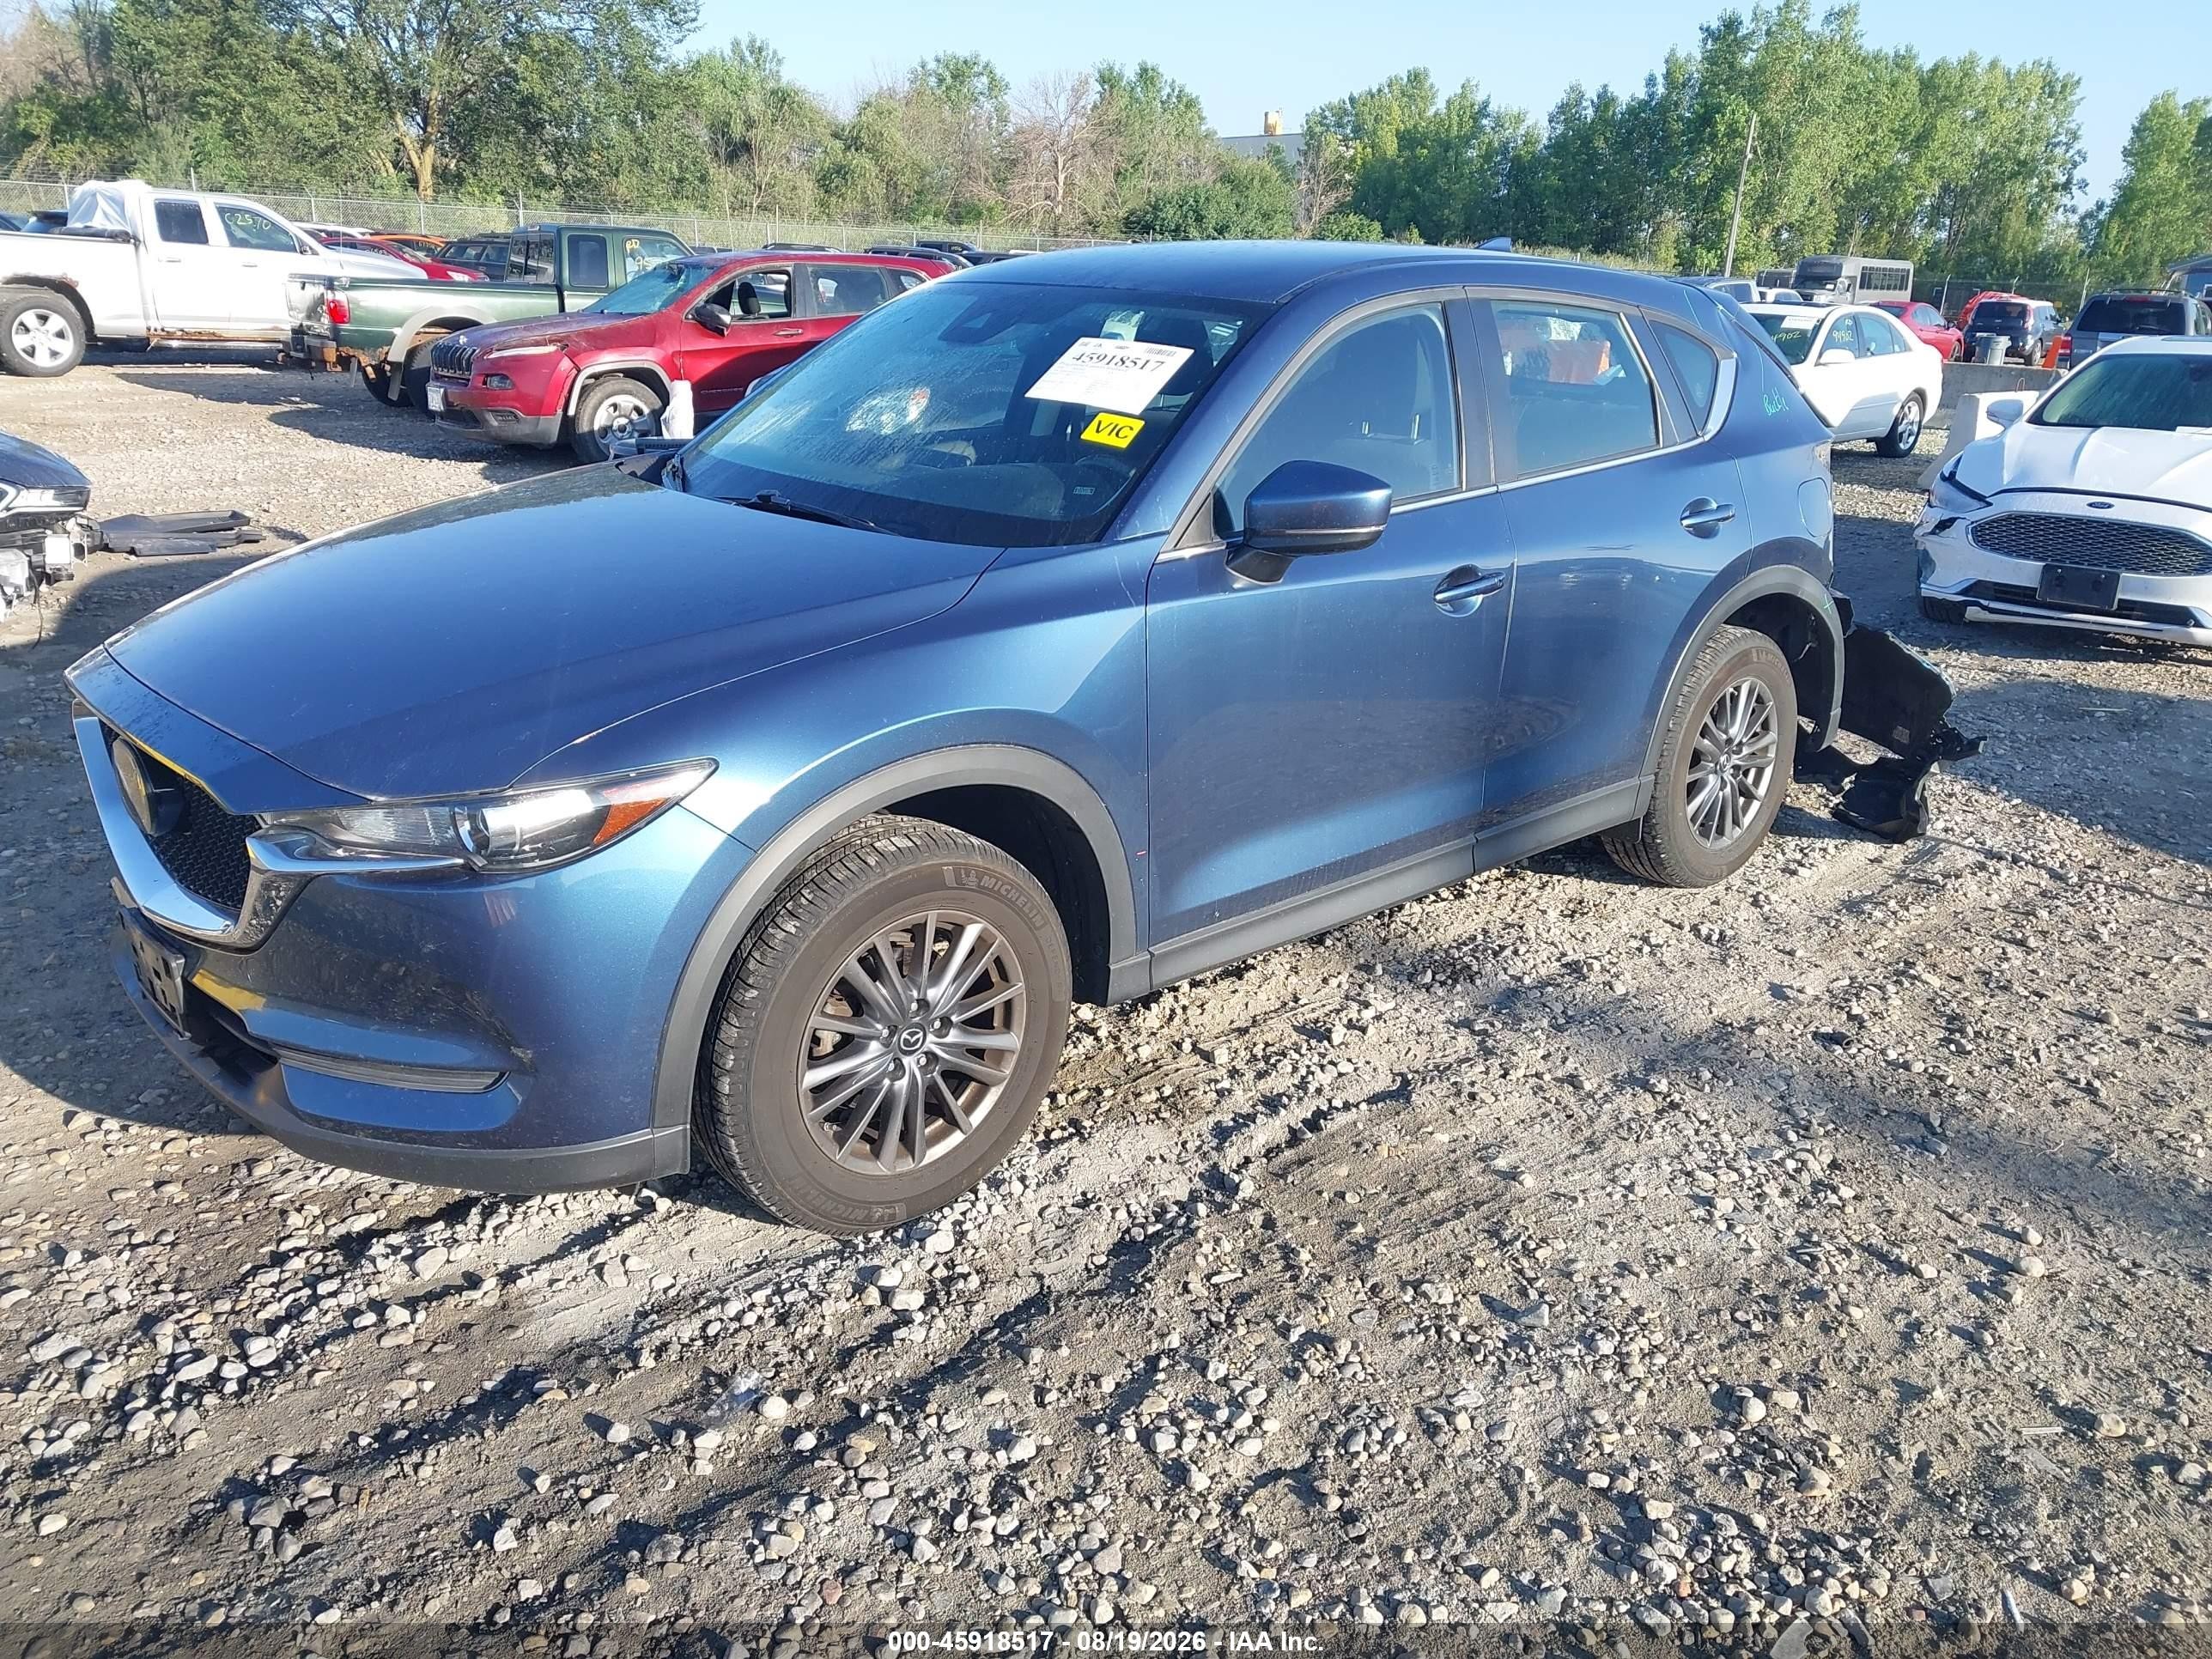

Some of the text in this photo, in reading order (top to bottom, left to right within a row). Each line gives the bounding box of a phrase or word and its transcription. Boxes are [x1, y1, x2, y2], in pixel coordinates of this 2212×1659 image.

[1072, 352, 1167, 372] 45918517
[1094, 419, 1134, 440] VIC
[980, 874, 1047, 929] MICHELIN
